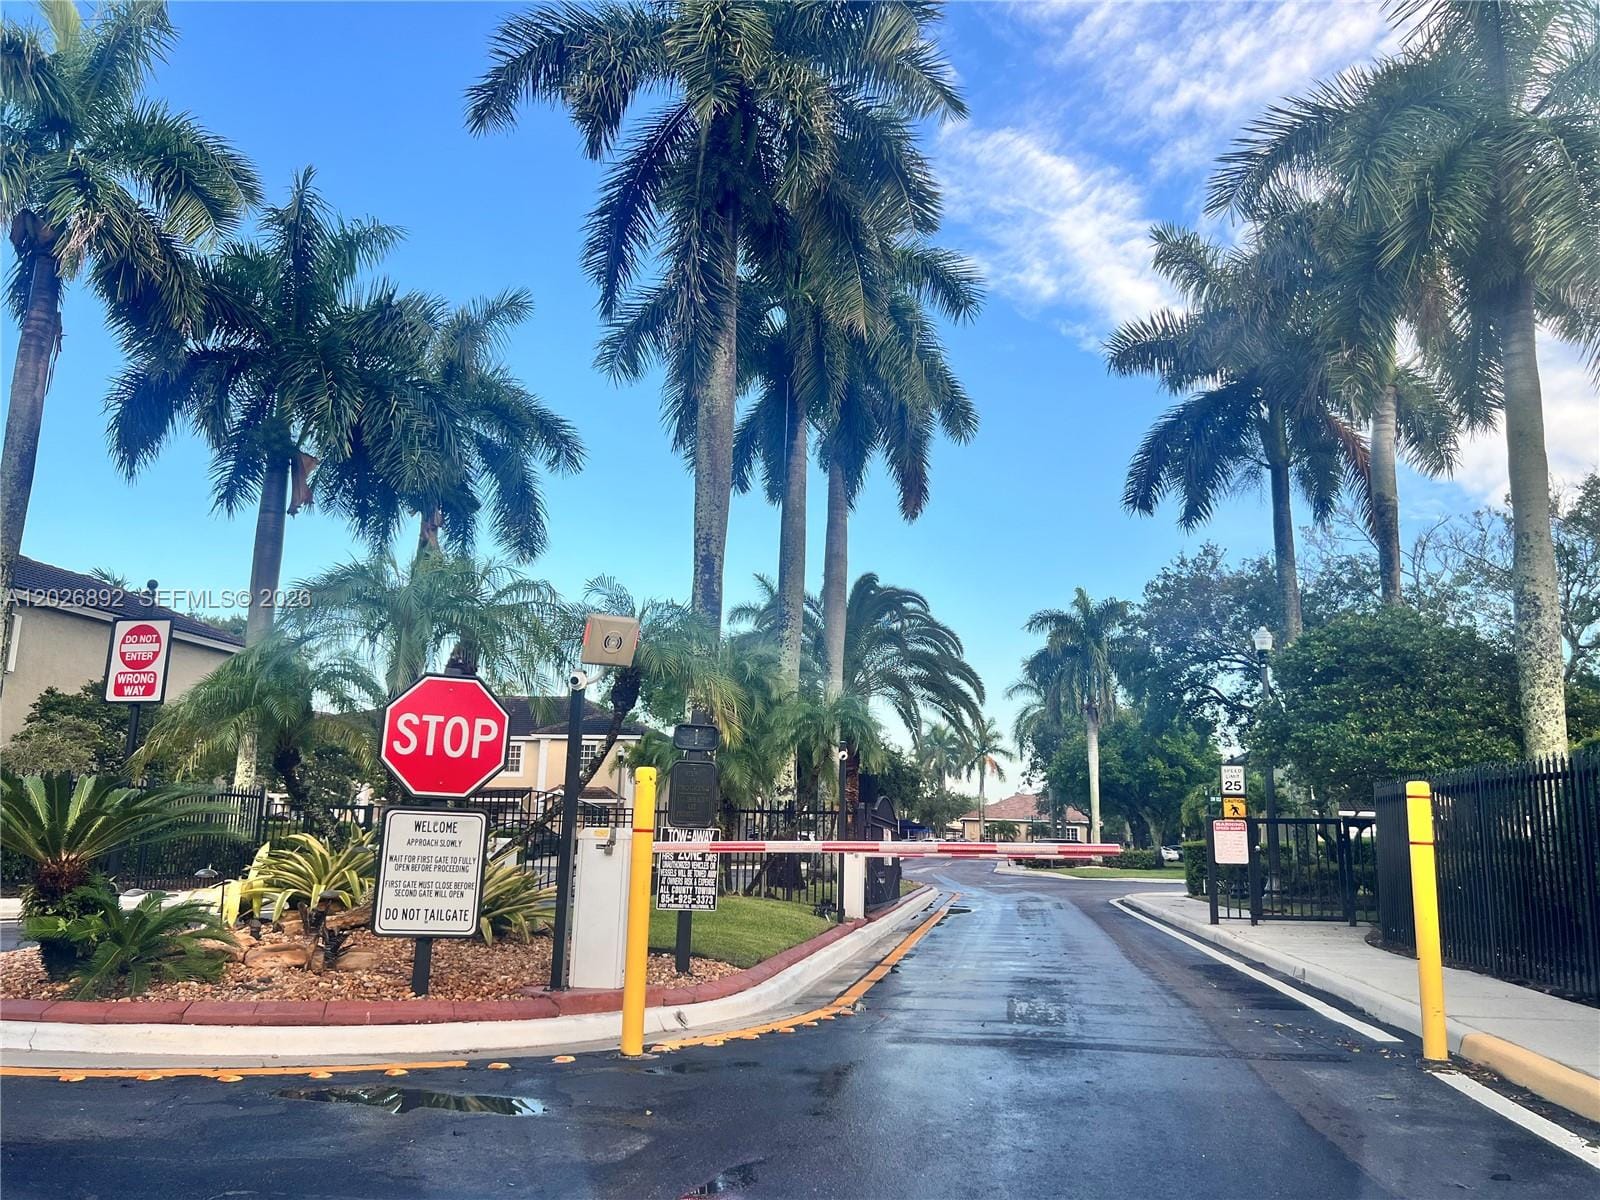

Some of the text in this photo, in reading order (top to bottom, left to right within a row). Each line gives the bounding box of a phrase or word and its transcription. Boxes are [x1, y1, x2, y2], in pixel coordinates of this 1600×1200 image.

[125, 634, 158, 643] DO NOT
[125, 651, 154, 661] ENTER
[117, 673, 154, 684] WRONG
[123, 685, 146, 696] WAY
[392, 712, 499, 759] STOP
[1225, 780, 1242, 791] 25
[414, 821, 458, 833] WELCOME
[667, 829, 715, 842] TOW-AWAY
[406, 838, 463, 848] APPROACH SLOWLY
[389, 855, 477, 866] WAIT FOR FIRST GATE TO FULLY
[394, 863, 469, 873] OPEN BEFORE PROCEEDING
[385, 880, 475, 891] FIRST GATE MUST CLOSE BEFORE
[660, 885, 670, 894] ALL
[671, 886, 694, 895] COUNTY
[394, 889, 465, 899] SECOND GATE WILL OPEN
[385, 907, 469, 921] DO NOT TAILGATE
